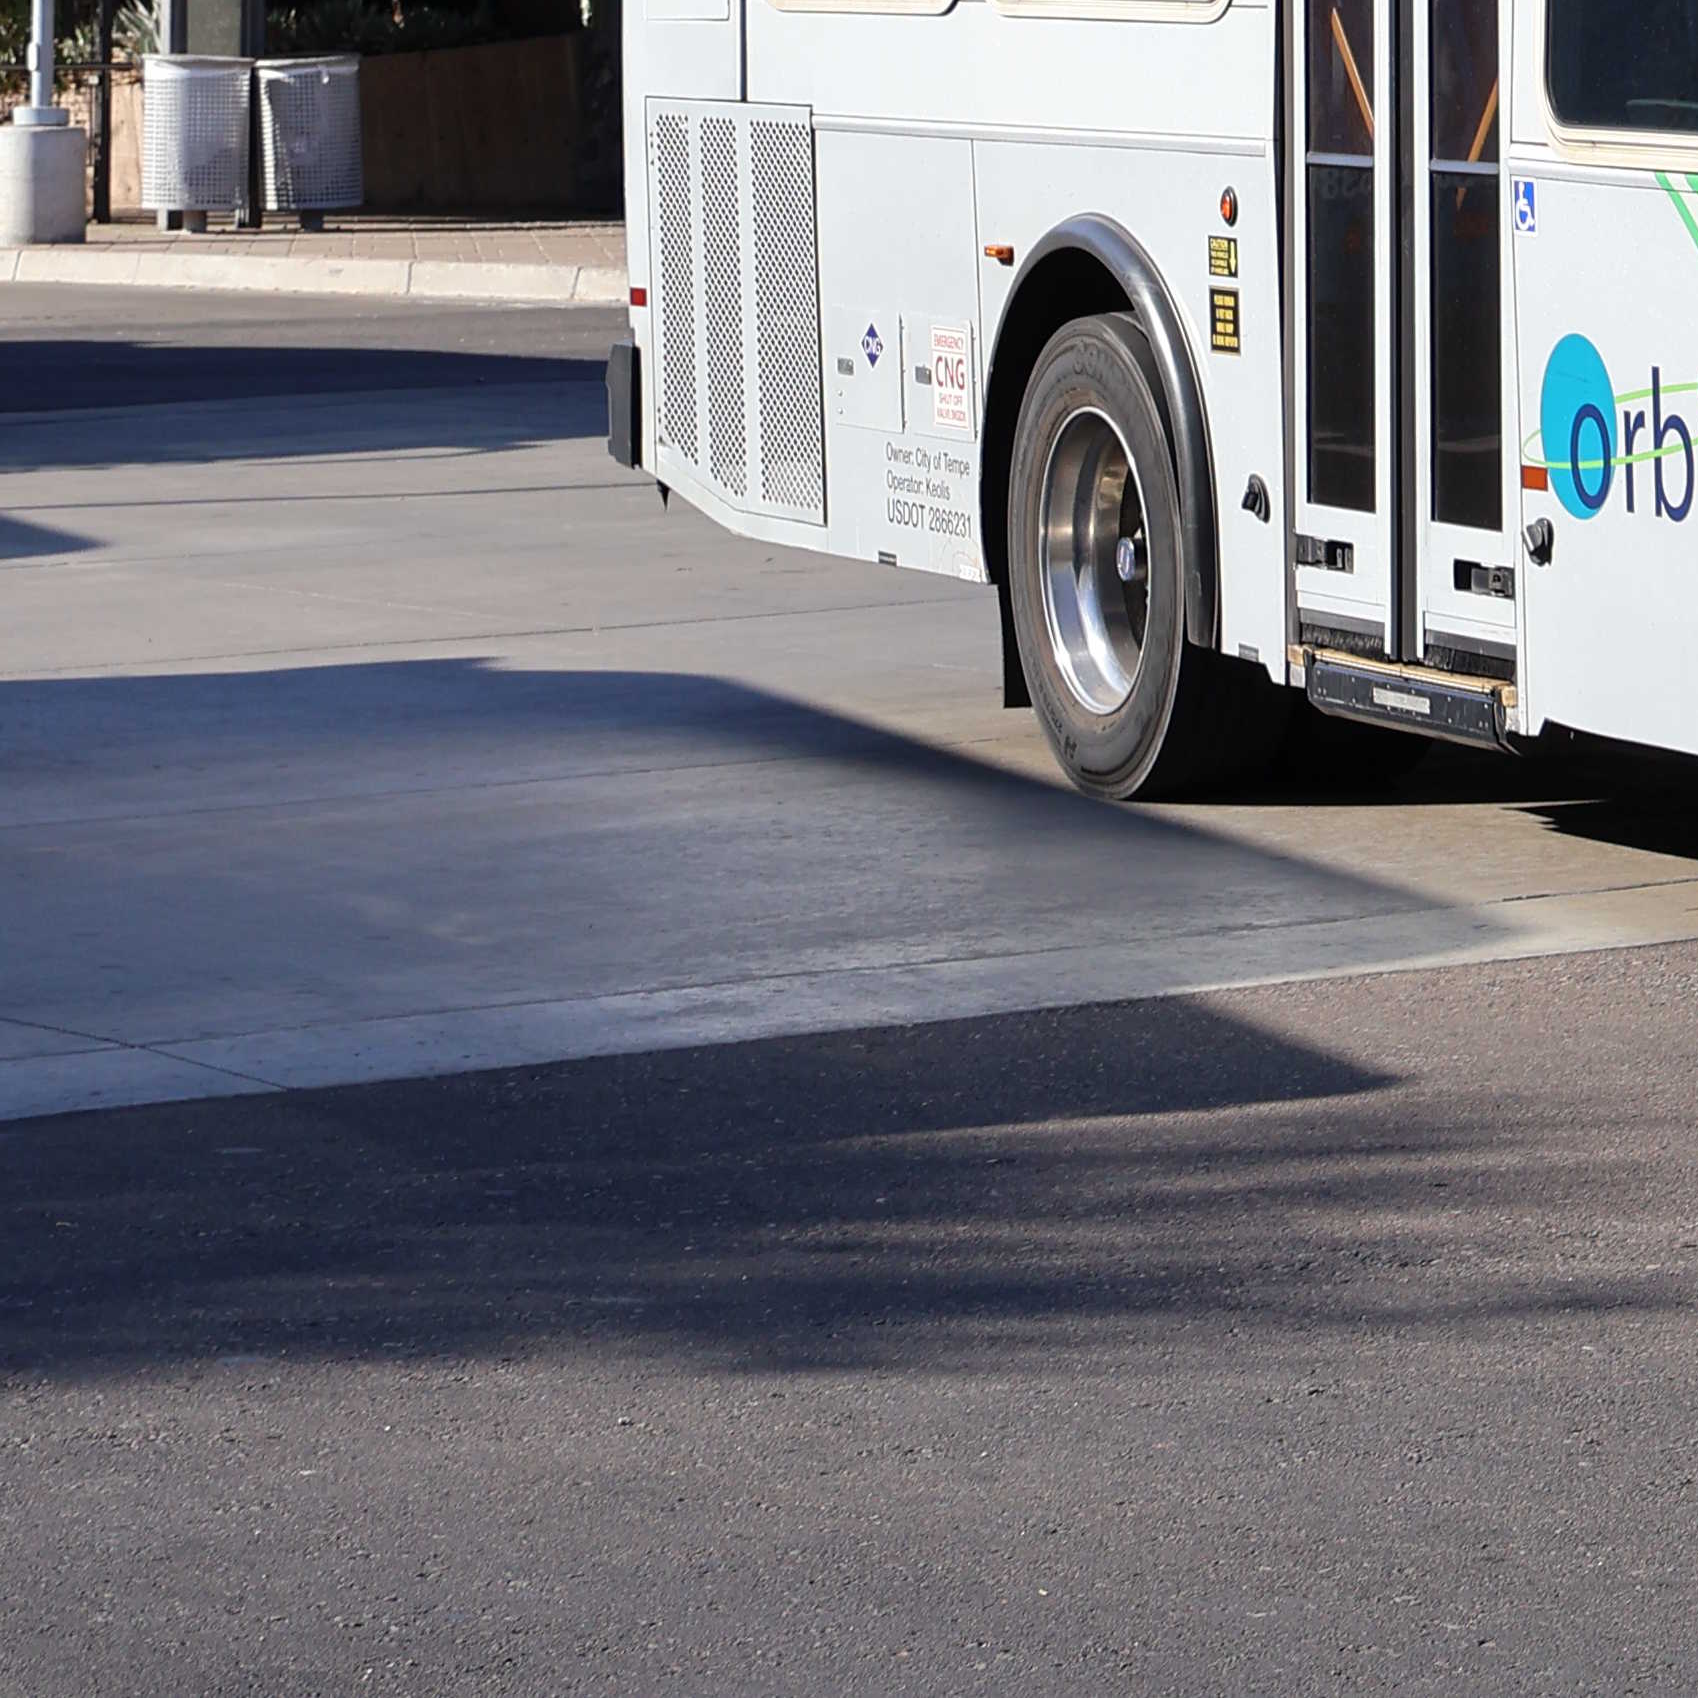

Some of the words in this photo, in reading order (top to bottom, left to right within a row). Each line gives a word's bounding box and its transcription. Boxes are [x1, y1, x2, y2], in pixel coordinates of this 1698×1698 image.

[864, 335, 881, 355] CNG
[935, 355, 965, 390] CNG
[886, 441, 914, 462] Owner:
[915, 447, 931, 473] City
[933, 452, 942, 471] of
[943, 452, 970, 477] Tempe
[926, 477, 951, 501] Keolis
[887, 497, 926, 529] USDOT
